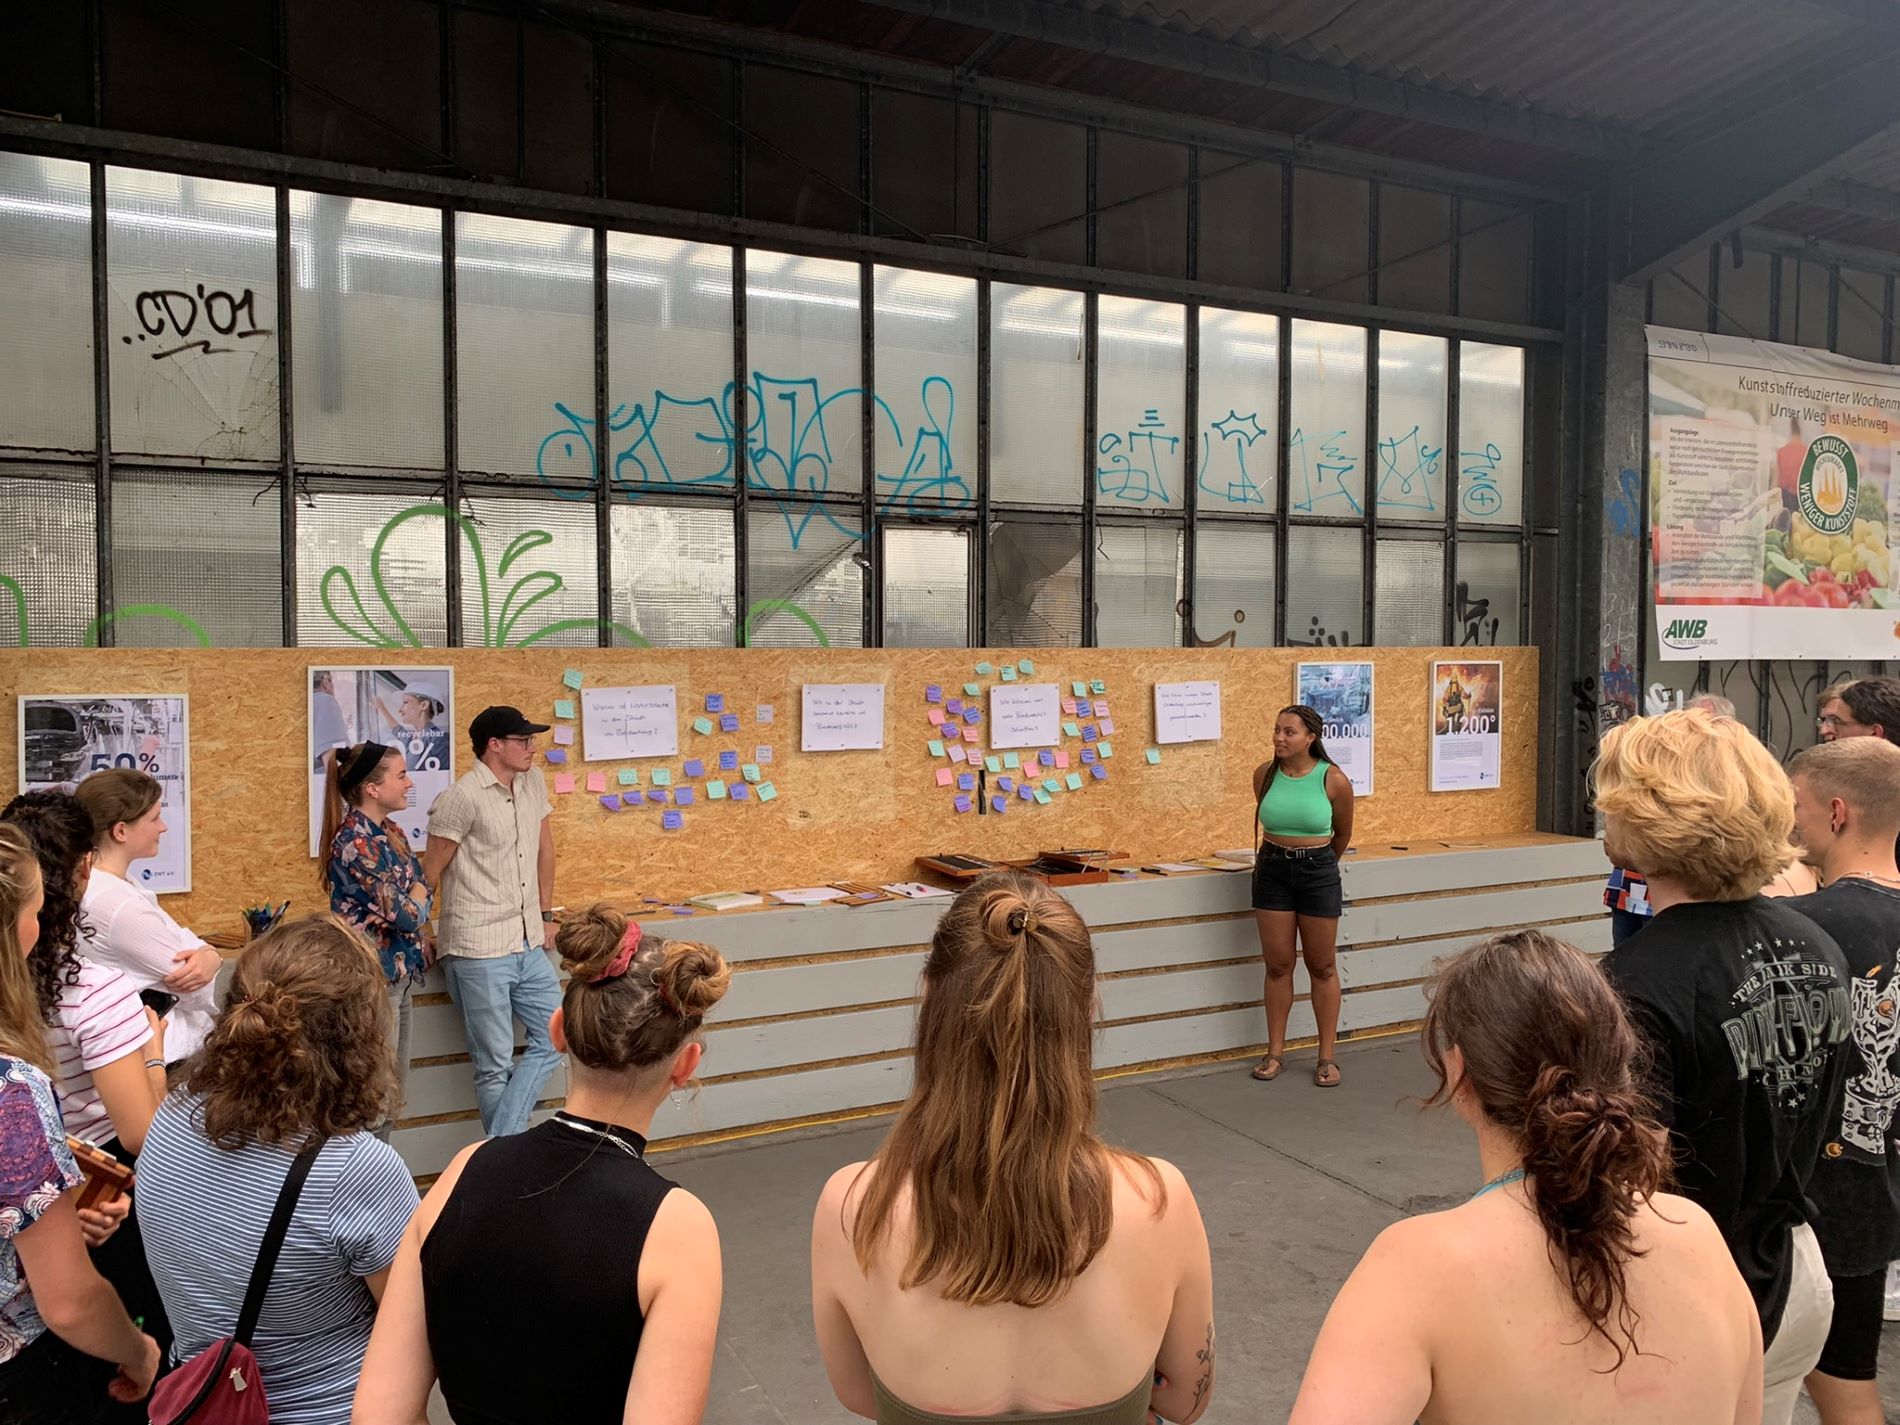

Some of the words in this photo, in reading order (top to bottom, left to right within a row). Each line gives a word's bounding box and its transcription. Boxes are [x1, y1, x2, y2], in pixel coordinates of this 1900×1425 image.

[1738, 375, 1850, 404] Kunststoffreduzierter
[1770, 402, 1801, 420] Unser
[1803, 407, 1827, 427] Weg
[1829, 412, 1840, 425] ist
[1842, 412, 1889, 433] Mehrweg
[1812, 438, 1849, 458] BEWUSST
[1799, 481, 1825, 528] WENIGER
[1824, 486, 1857, 530] KUNSTSTOFF
[1664, 619, 1708, 639] AWB
[396, 729, 446, 740] recyclebar
[1320, 723, 1369, 739] 00.000
[1446, 714, 1496, 735] 1.200°
[91, 752, 160, 774] 50%
[1732, 975, 1762, 1003] THE
